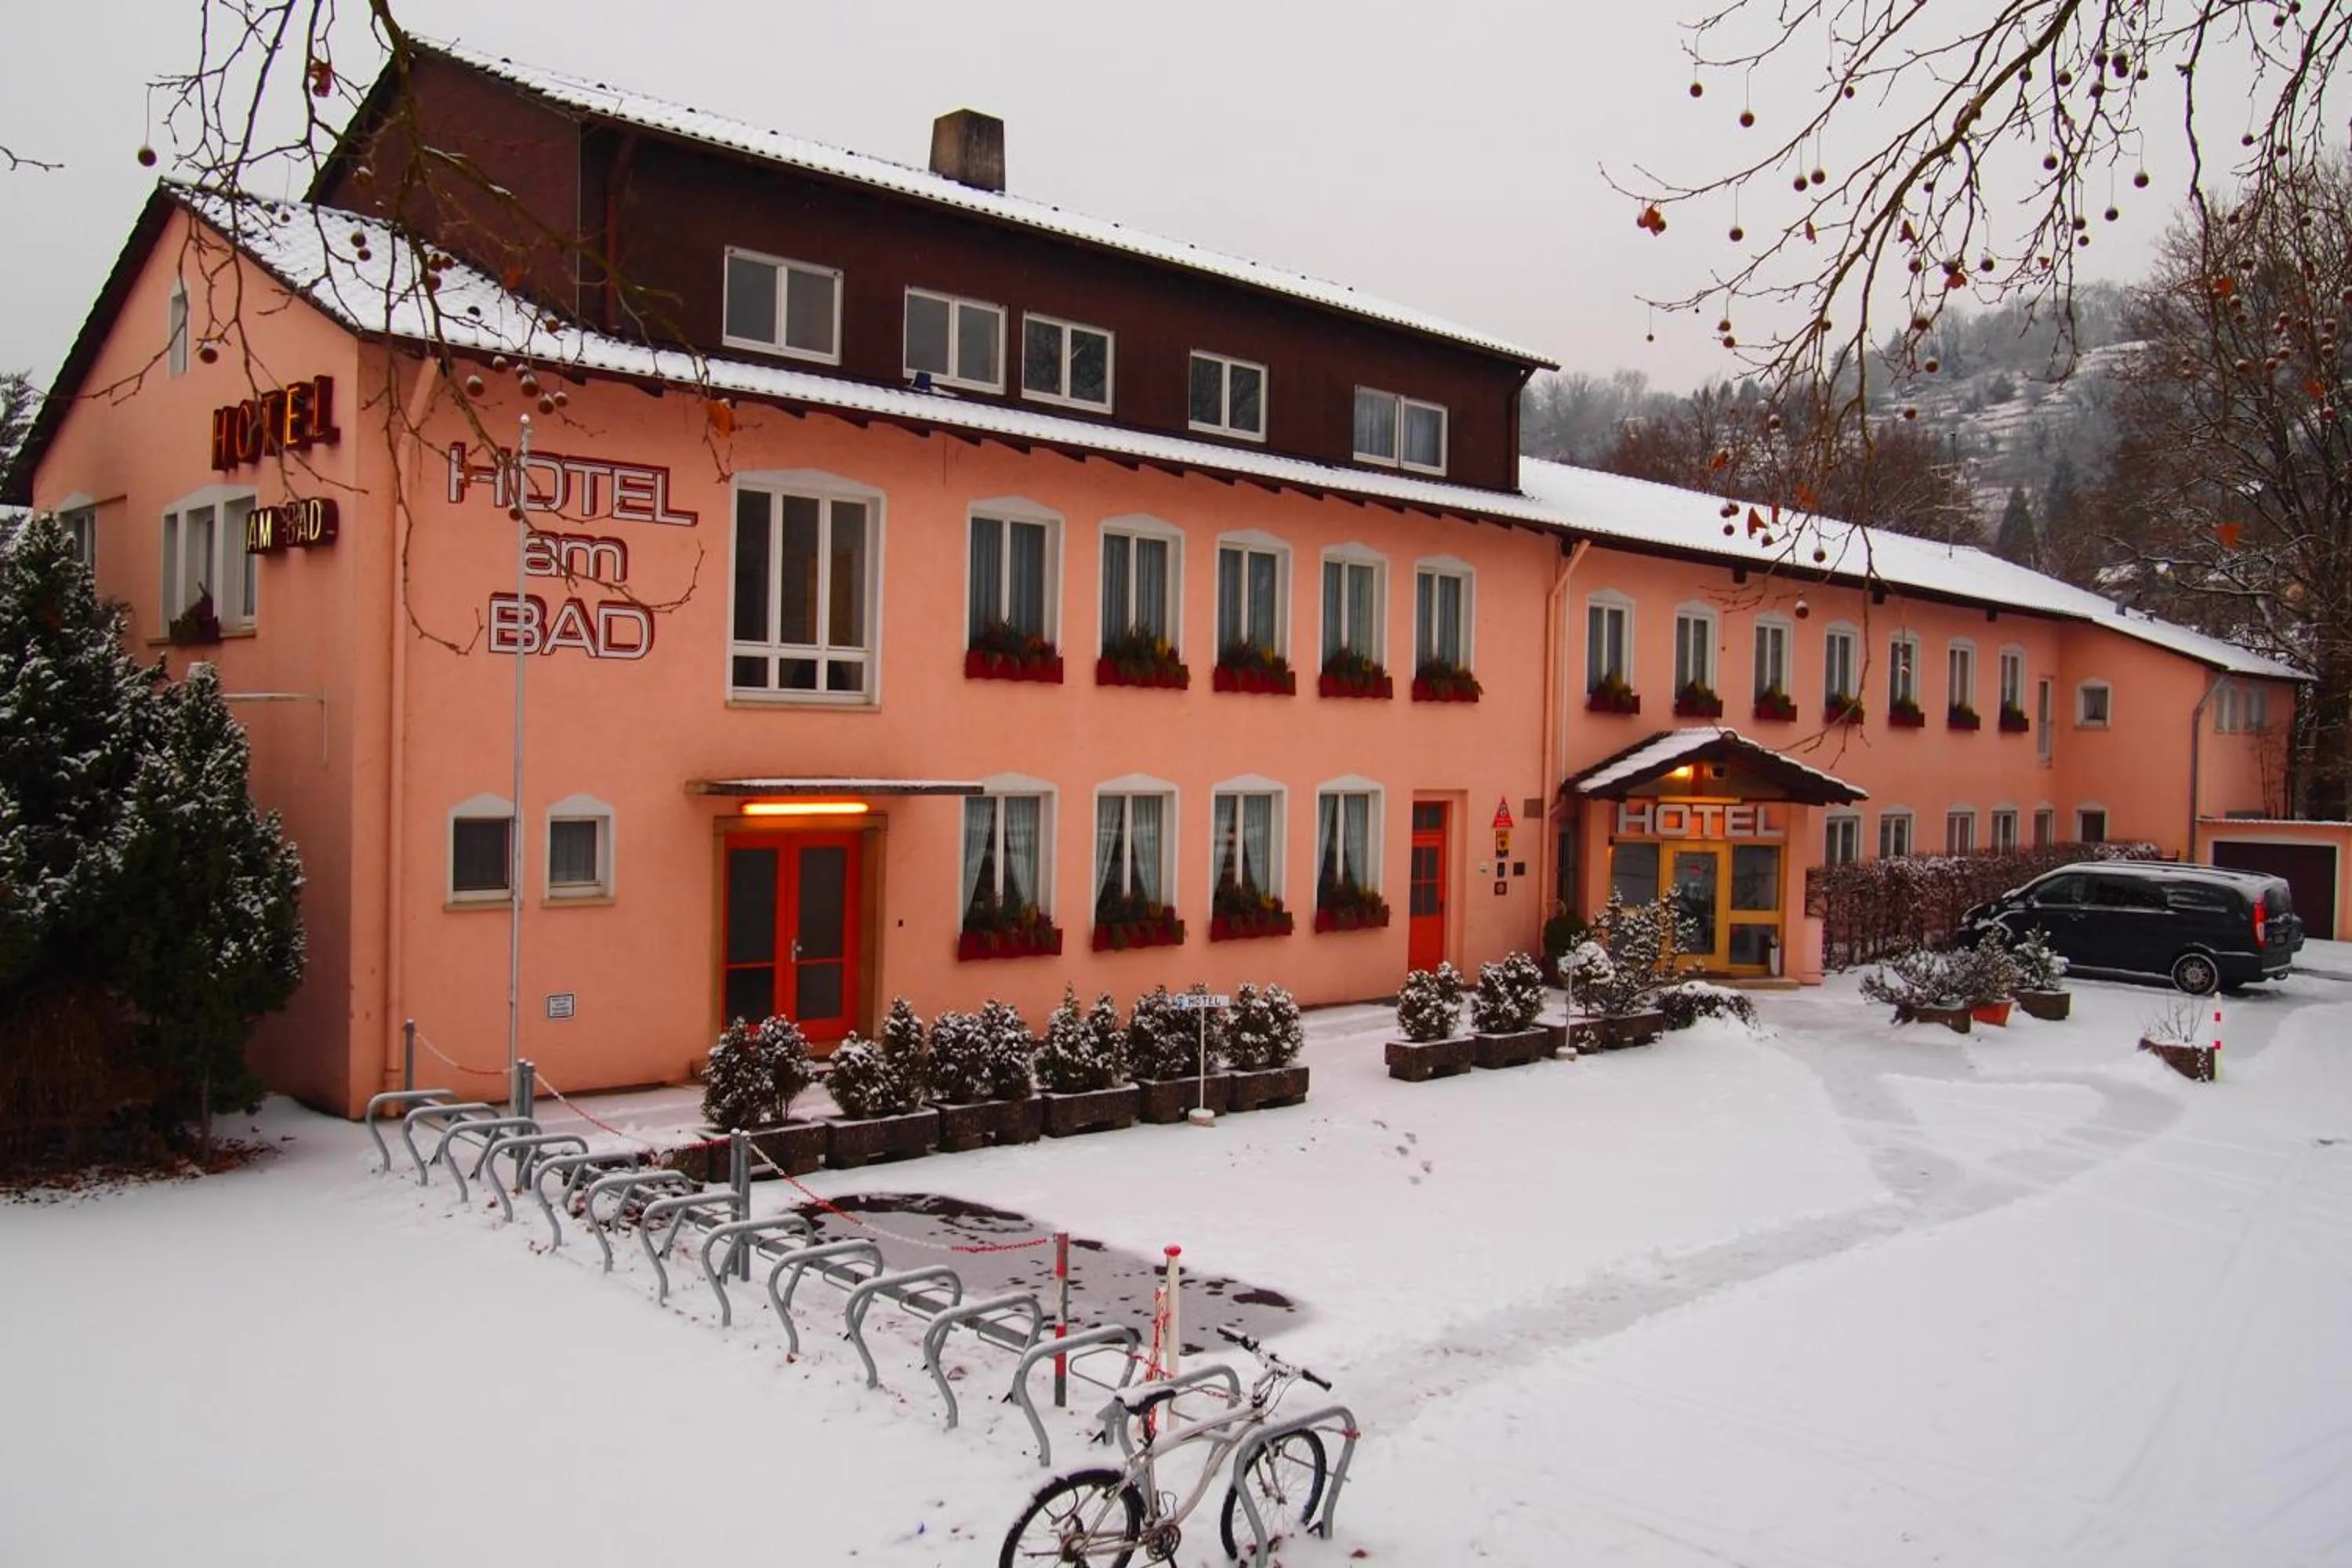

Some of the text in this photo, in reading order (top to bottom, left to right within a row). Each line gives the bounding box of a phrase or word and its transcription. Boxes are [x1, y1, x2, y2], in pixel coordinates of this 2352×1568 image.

[212, 376, 339, 472] HOTEL
[448, 441, 699, 527] HOTEL
[246, 498, 336, 554] AM BAD
[523, 530, 628, 583] am
[488, 591, 655, 660] BAD
[1617, 802, 1785, 838] HOTEL
